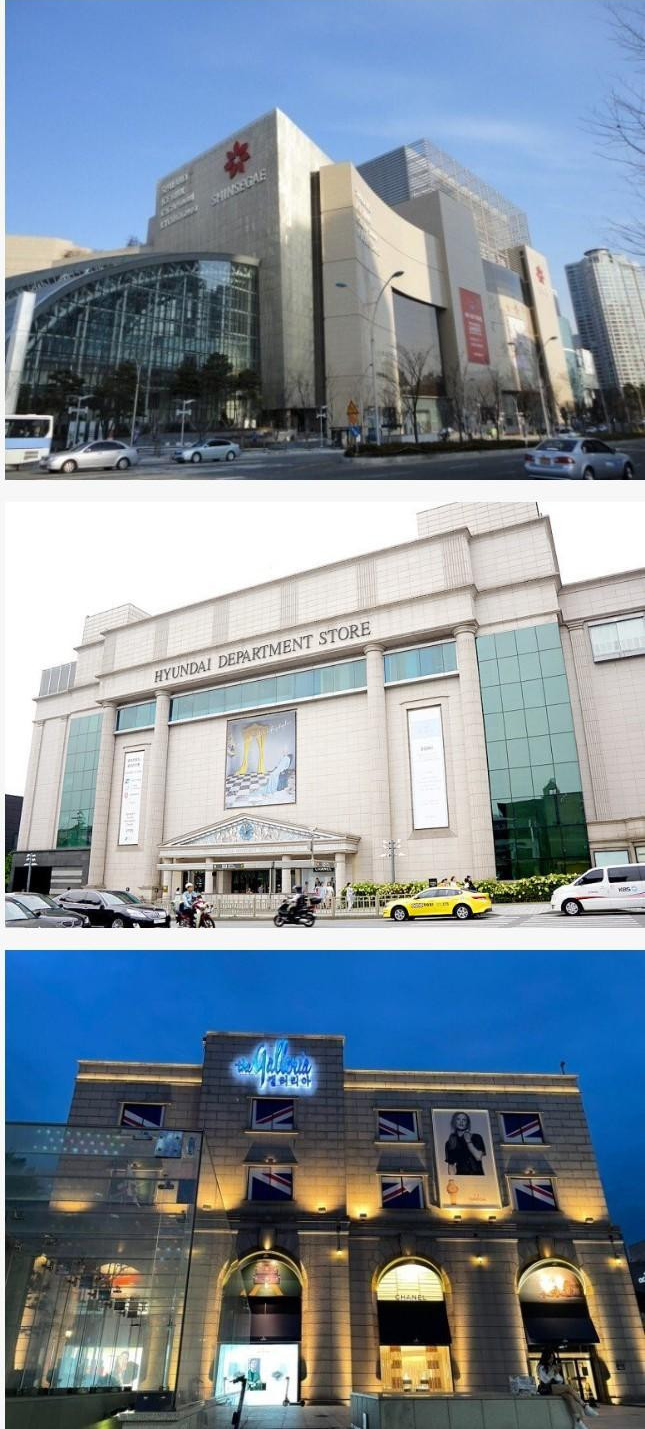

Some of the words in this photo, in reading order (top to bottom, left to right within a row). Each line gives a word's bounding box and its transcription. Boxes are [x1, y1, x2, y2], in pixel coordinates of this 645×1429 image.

[210, 167, 267, 205] SHINSEGAE
[154, 658, 211, 683] HYUNDAI
[218, 634, 314, 669] DEPARTMENT
[318, 621, 371, 646] STORE
